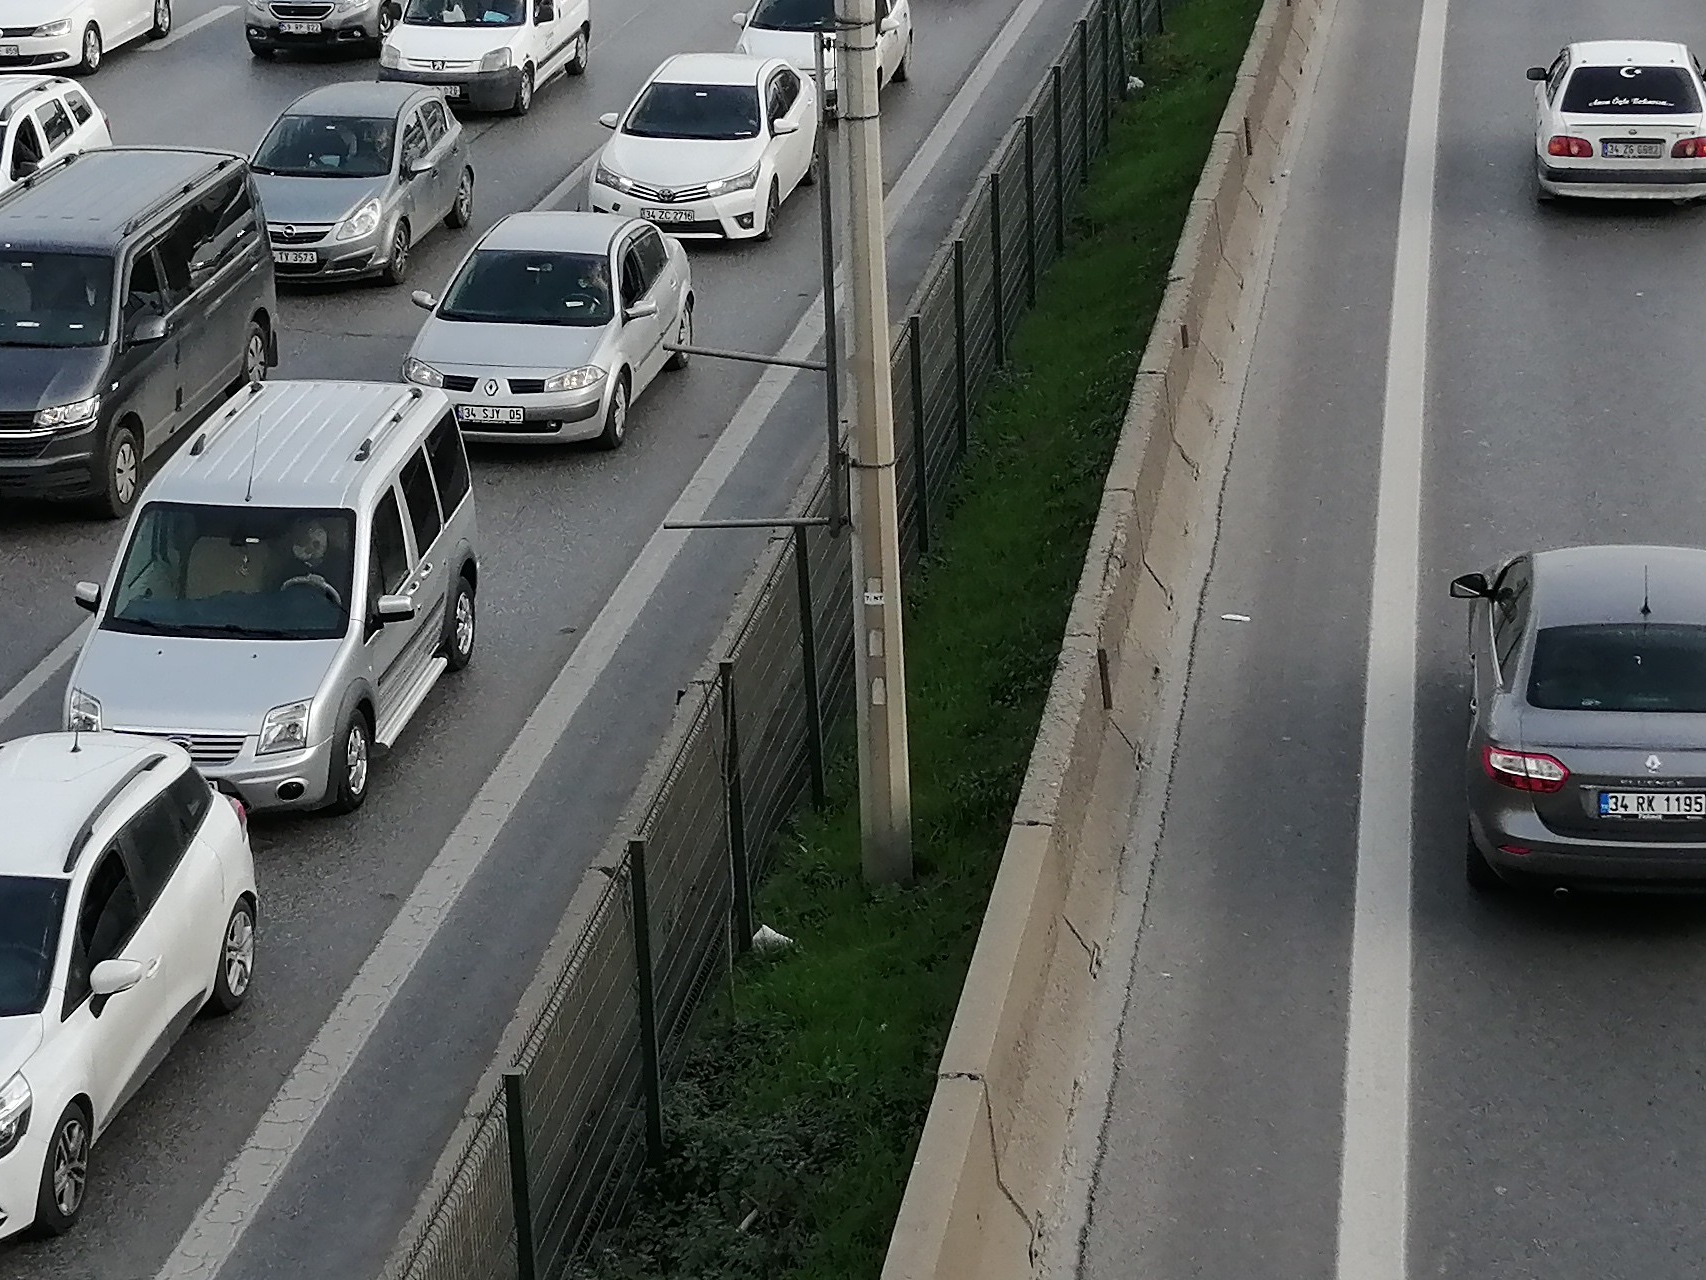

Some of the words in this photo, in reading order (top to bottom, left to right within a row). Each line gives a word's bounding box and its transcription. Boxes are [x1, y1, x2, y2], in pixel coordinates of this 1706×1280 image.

[1608, 144, 1619, 154] 34
[644, 210, 656, 219] 34
[659, 210, 671, 220] ZC
[293, 252, 314, 262] 3573
[464, 408, 477, 418] 34
[482, 407, 501, 419] SJY
[509, 408, 522, 419] 05
[1609, 795, 1629, 812] 34
[1637, 795, 1655, 813] RK
[1664, 796, 1704, 813] 1195
